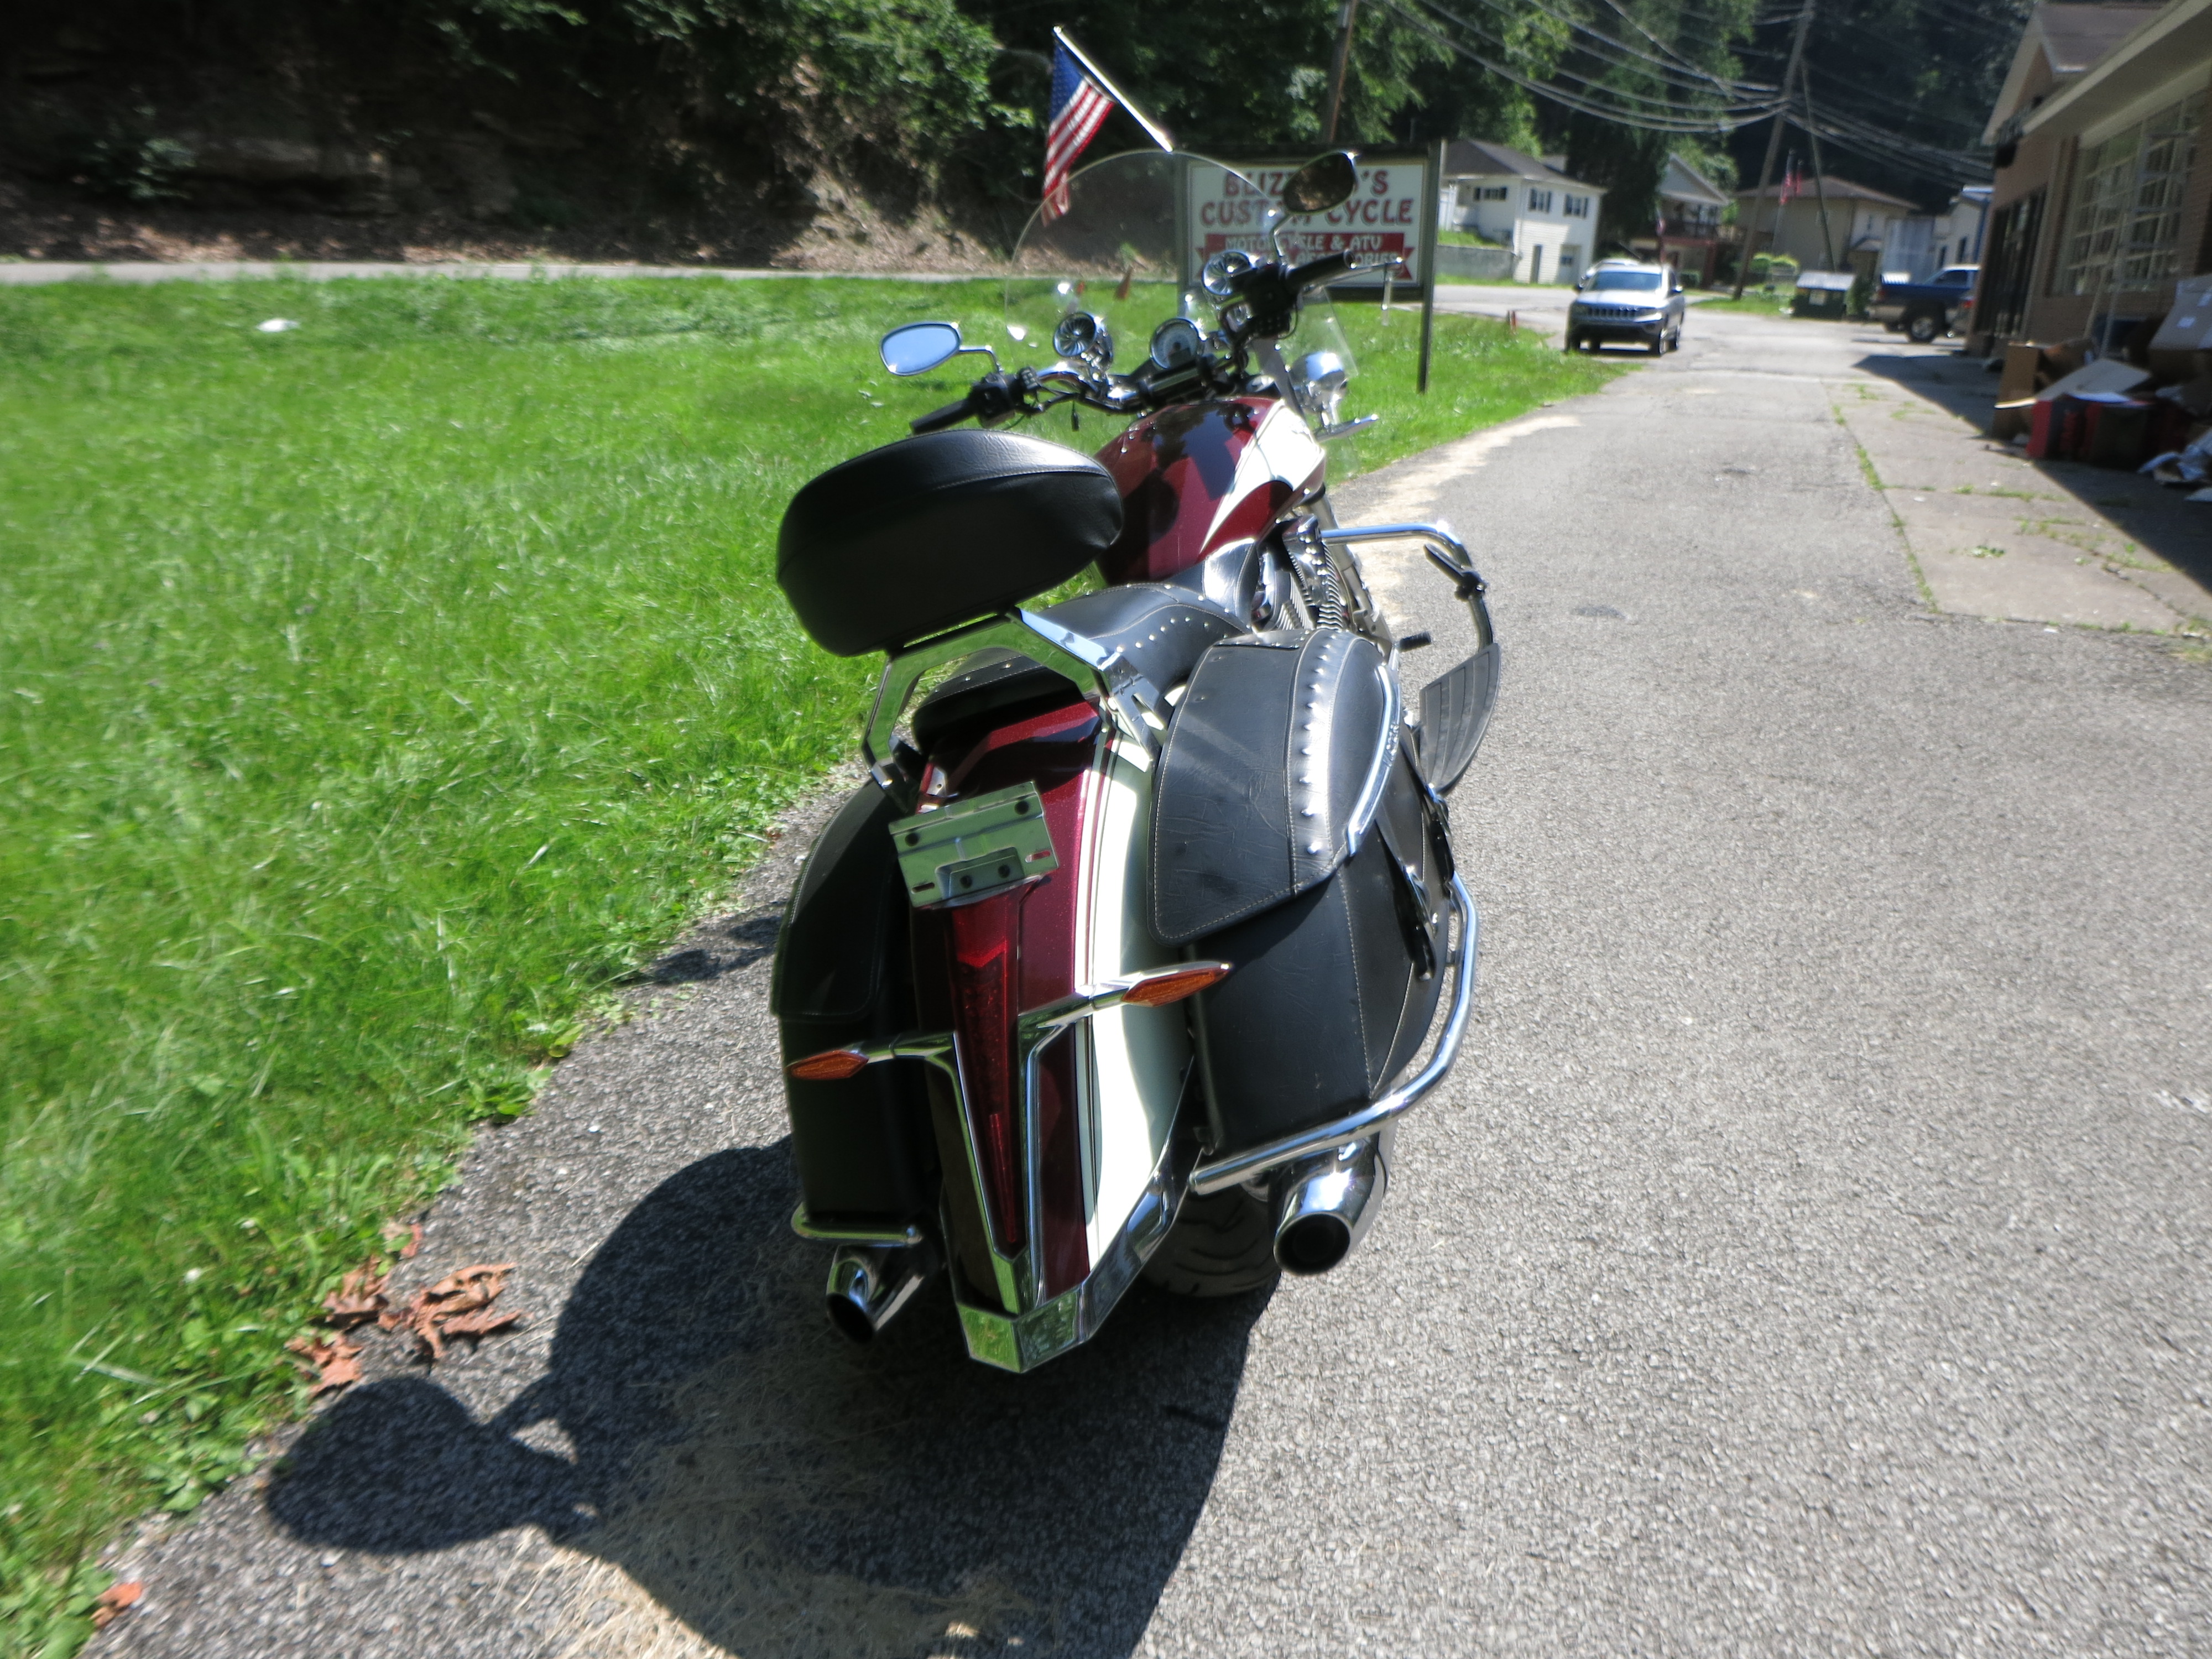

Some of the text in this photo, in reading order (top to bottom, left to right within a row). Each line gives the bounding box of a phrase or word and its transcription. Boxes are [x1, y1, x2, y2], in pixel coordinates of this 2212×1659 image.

[1200, 200, 1312, 225] CUST
[1330, 235, 1344, 250] &
[1350, 234, 1381, 250] ATV
